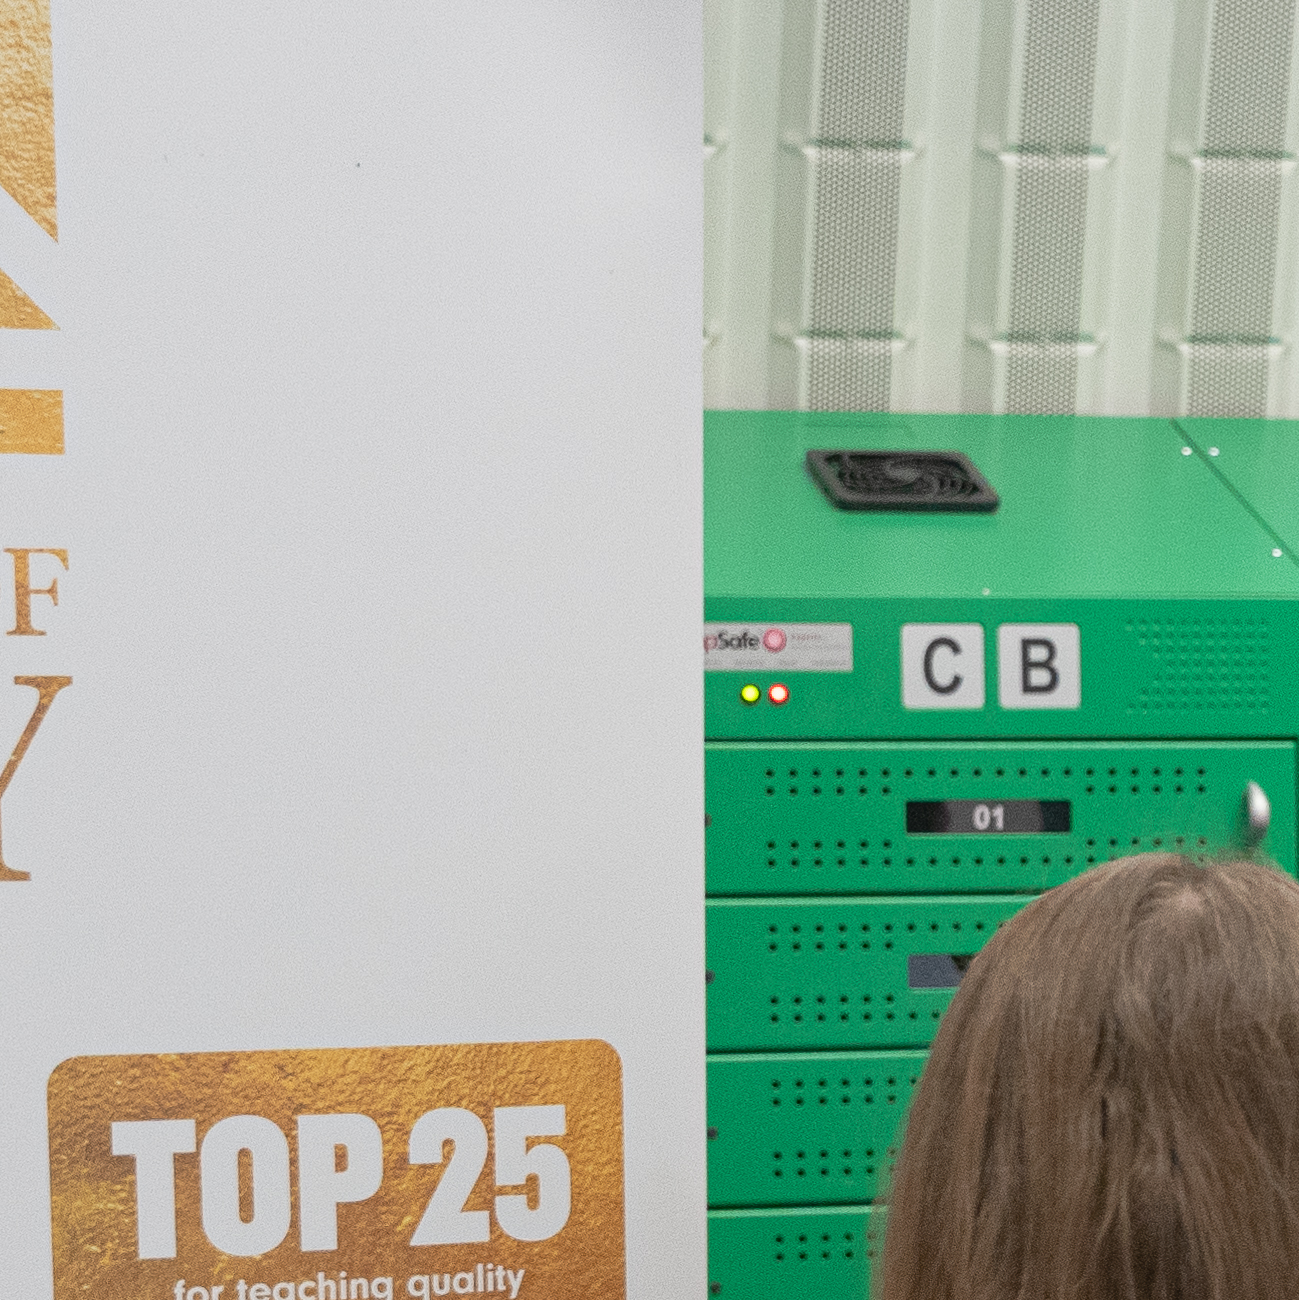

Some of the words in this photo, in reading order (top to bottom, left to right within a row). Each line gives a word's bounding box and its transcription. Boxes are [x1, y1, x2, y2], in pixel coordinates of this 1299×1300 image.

[922, 637, 963, 695] C
[1021, 638, 1060, 694] B
[973, 805, 1005, 830] 01
[110, 1111, 384, 1261] TOP
[407, 1104, 572, 1247] 25
[406, 1264, 526, 1300] quality
